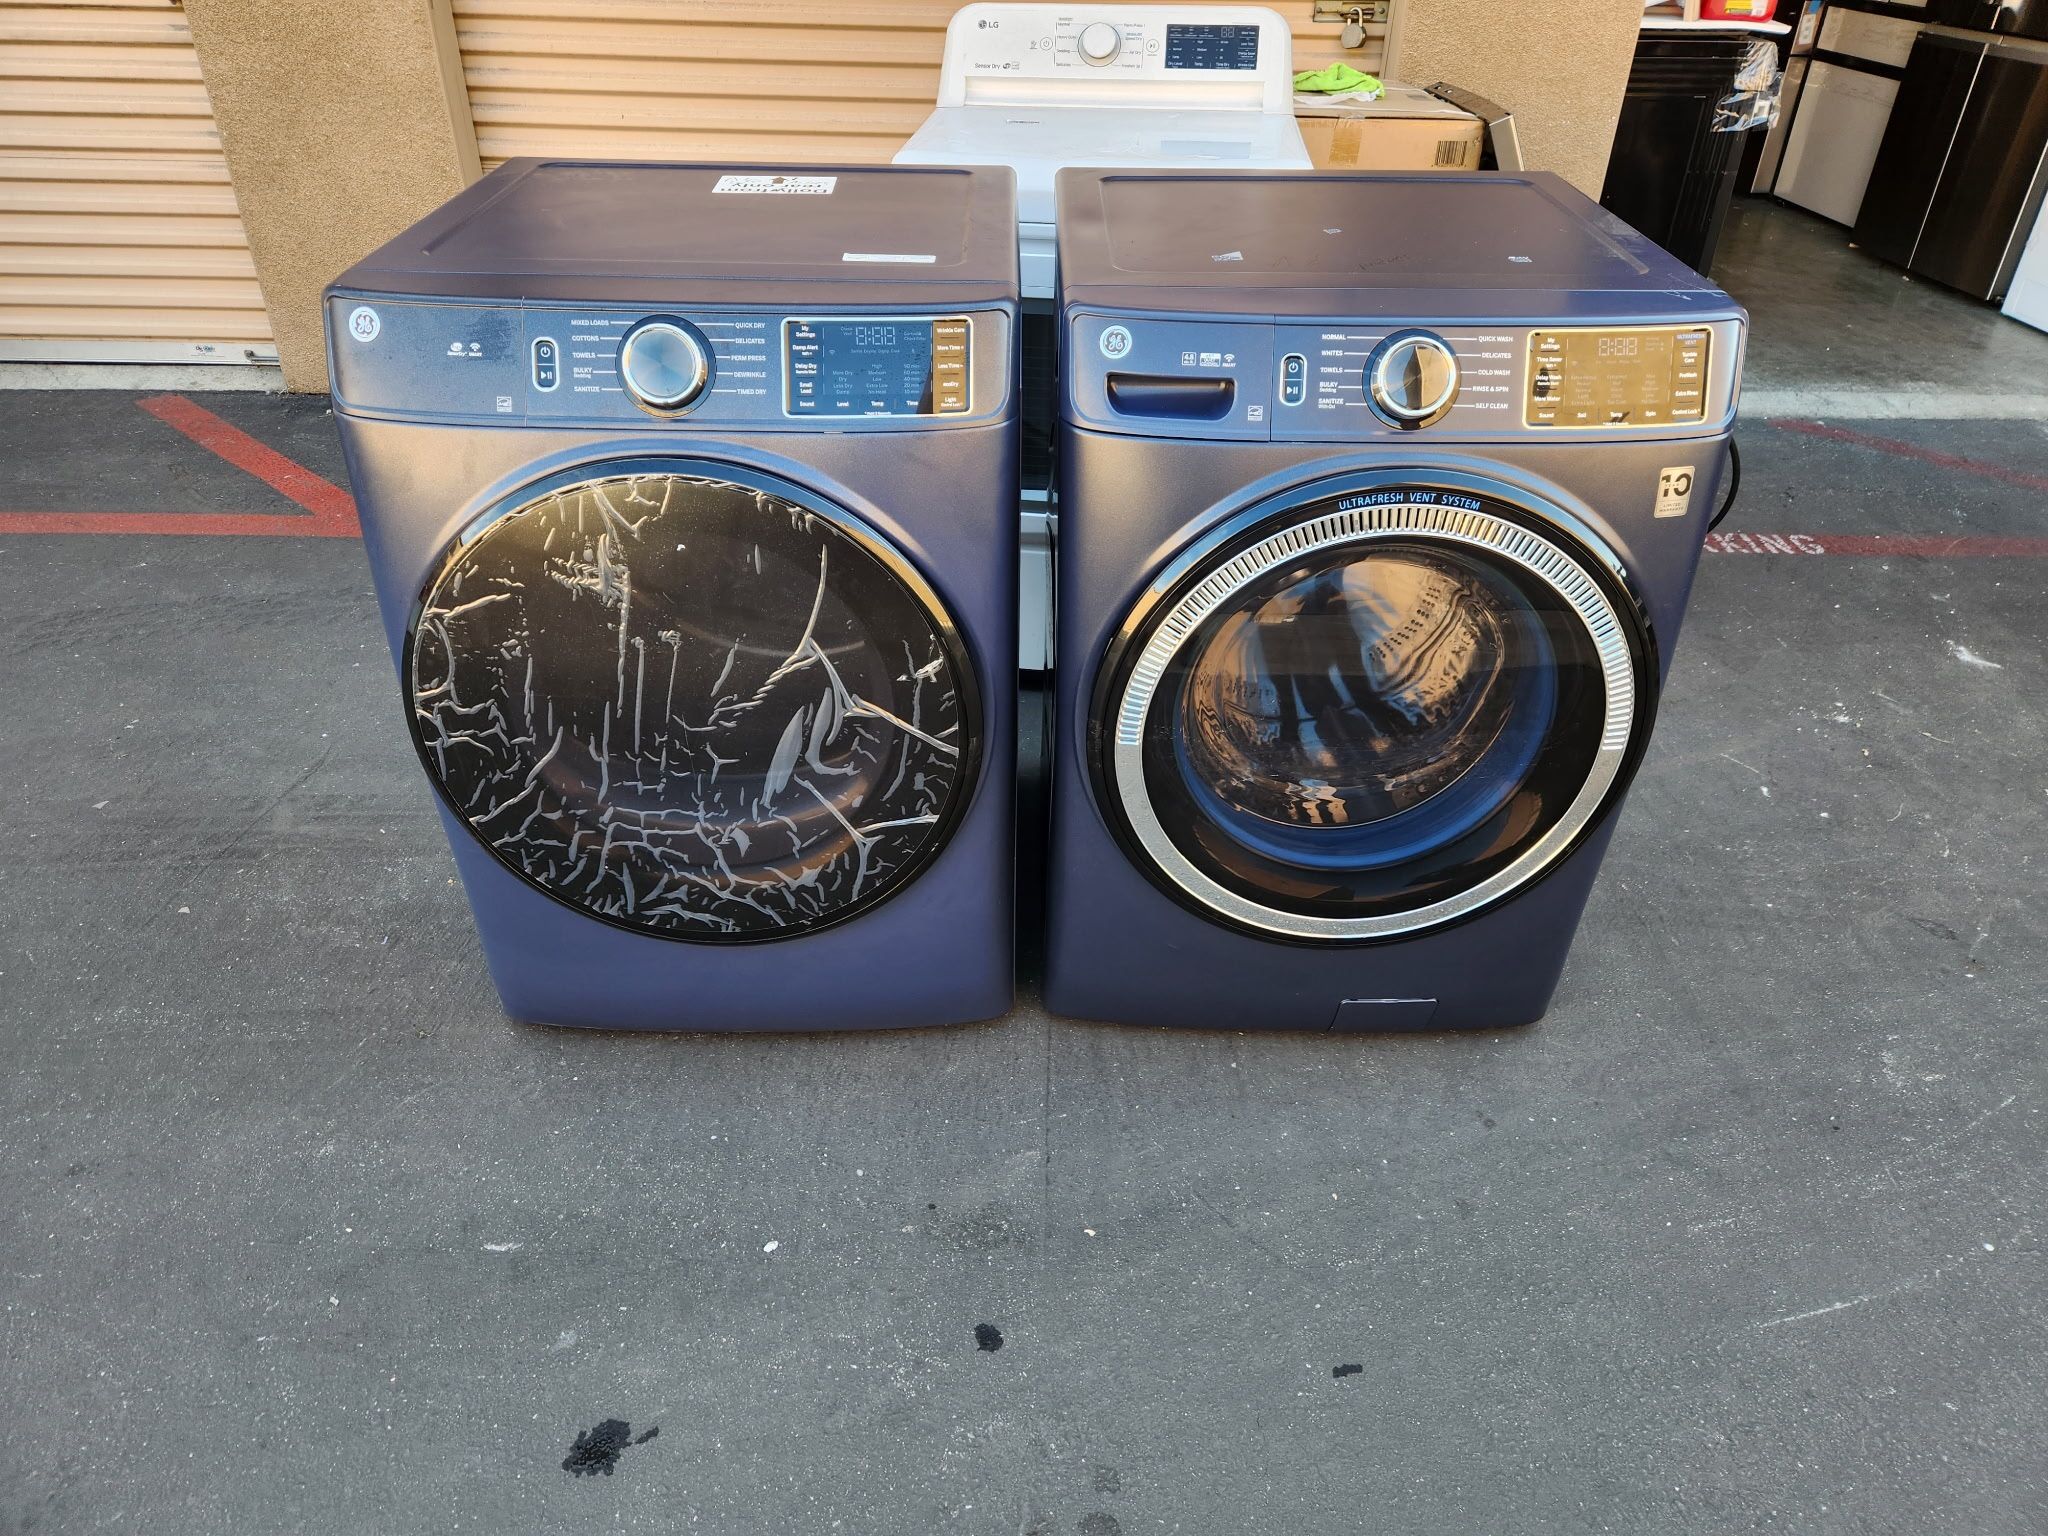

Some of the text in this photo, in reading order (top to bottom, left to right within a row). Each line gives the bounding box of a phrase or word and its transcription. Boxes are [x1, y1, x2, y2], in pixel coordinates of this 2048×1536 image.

[1661, 473, 1692, 498] 10
[1339, 493, 1481, 510] ULTRAFRESH VENT SYSTEM
[1702, 533, 1825, 555] KING
